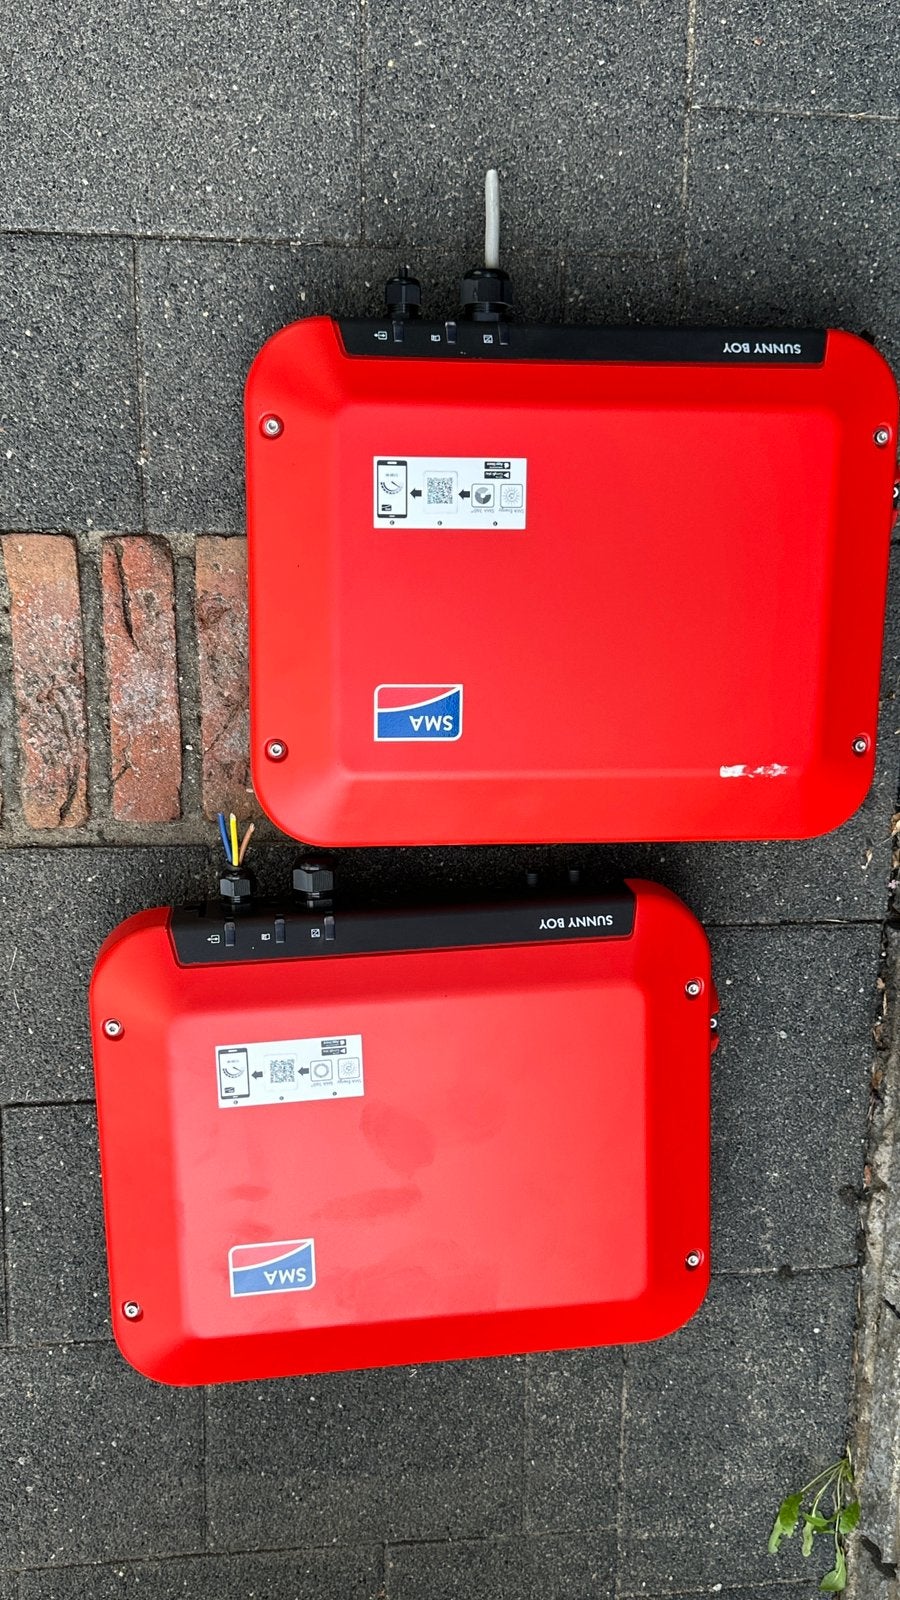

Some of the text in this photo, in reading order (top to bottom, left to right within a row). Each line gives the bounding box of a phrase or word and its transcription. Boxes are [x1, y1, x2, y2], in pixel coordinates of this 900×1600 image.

[723, 342, 802, 354] SUNNY BOY
[409, 715, 454, 732] SMA
[539, 915, 613, 930] SUNNY BOY
[263, 1267, 307, 1286] SMA
